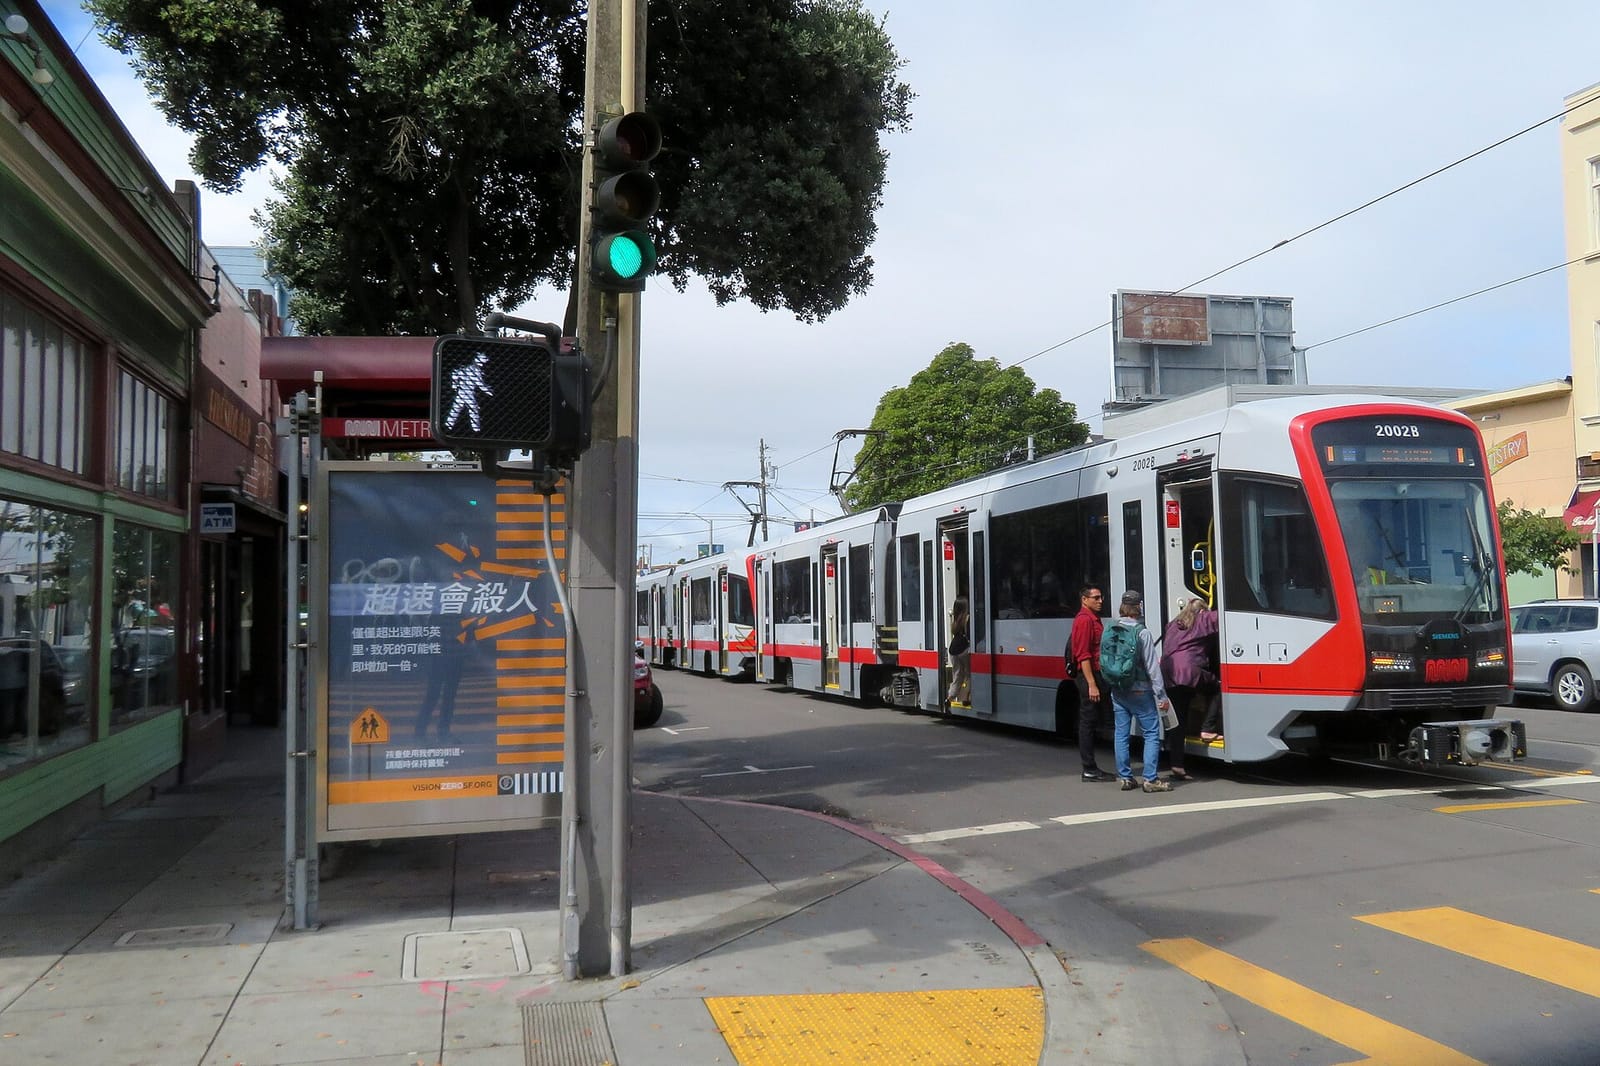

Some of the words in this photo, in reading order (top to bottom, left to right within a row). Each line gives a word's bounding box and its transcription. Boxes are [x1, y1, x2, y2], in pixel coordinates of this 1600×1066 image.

[383, 420, 433, 438] METR
[1374, 425, 1420, 437] 2002B
[1491, 438, 1522, 467] ISTRY
[1133, 456, 1155, 471] 2002B
[204, 517, 232, 527] ATM
[361, 582, 538, 615] 超速會殺人
[352, 626, 441, 639] 僅僅超出速限5英
